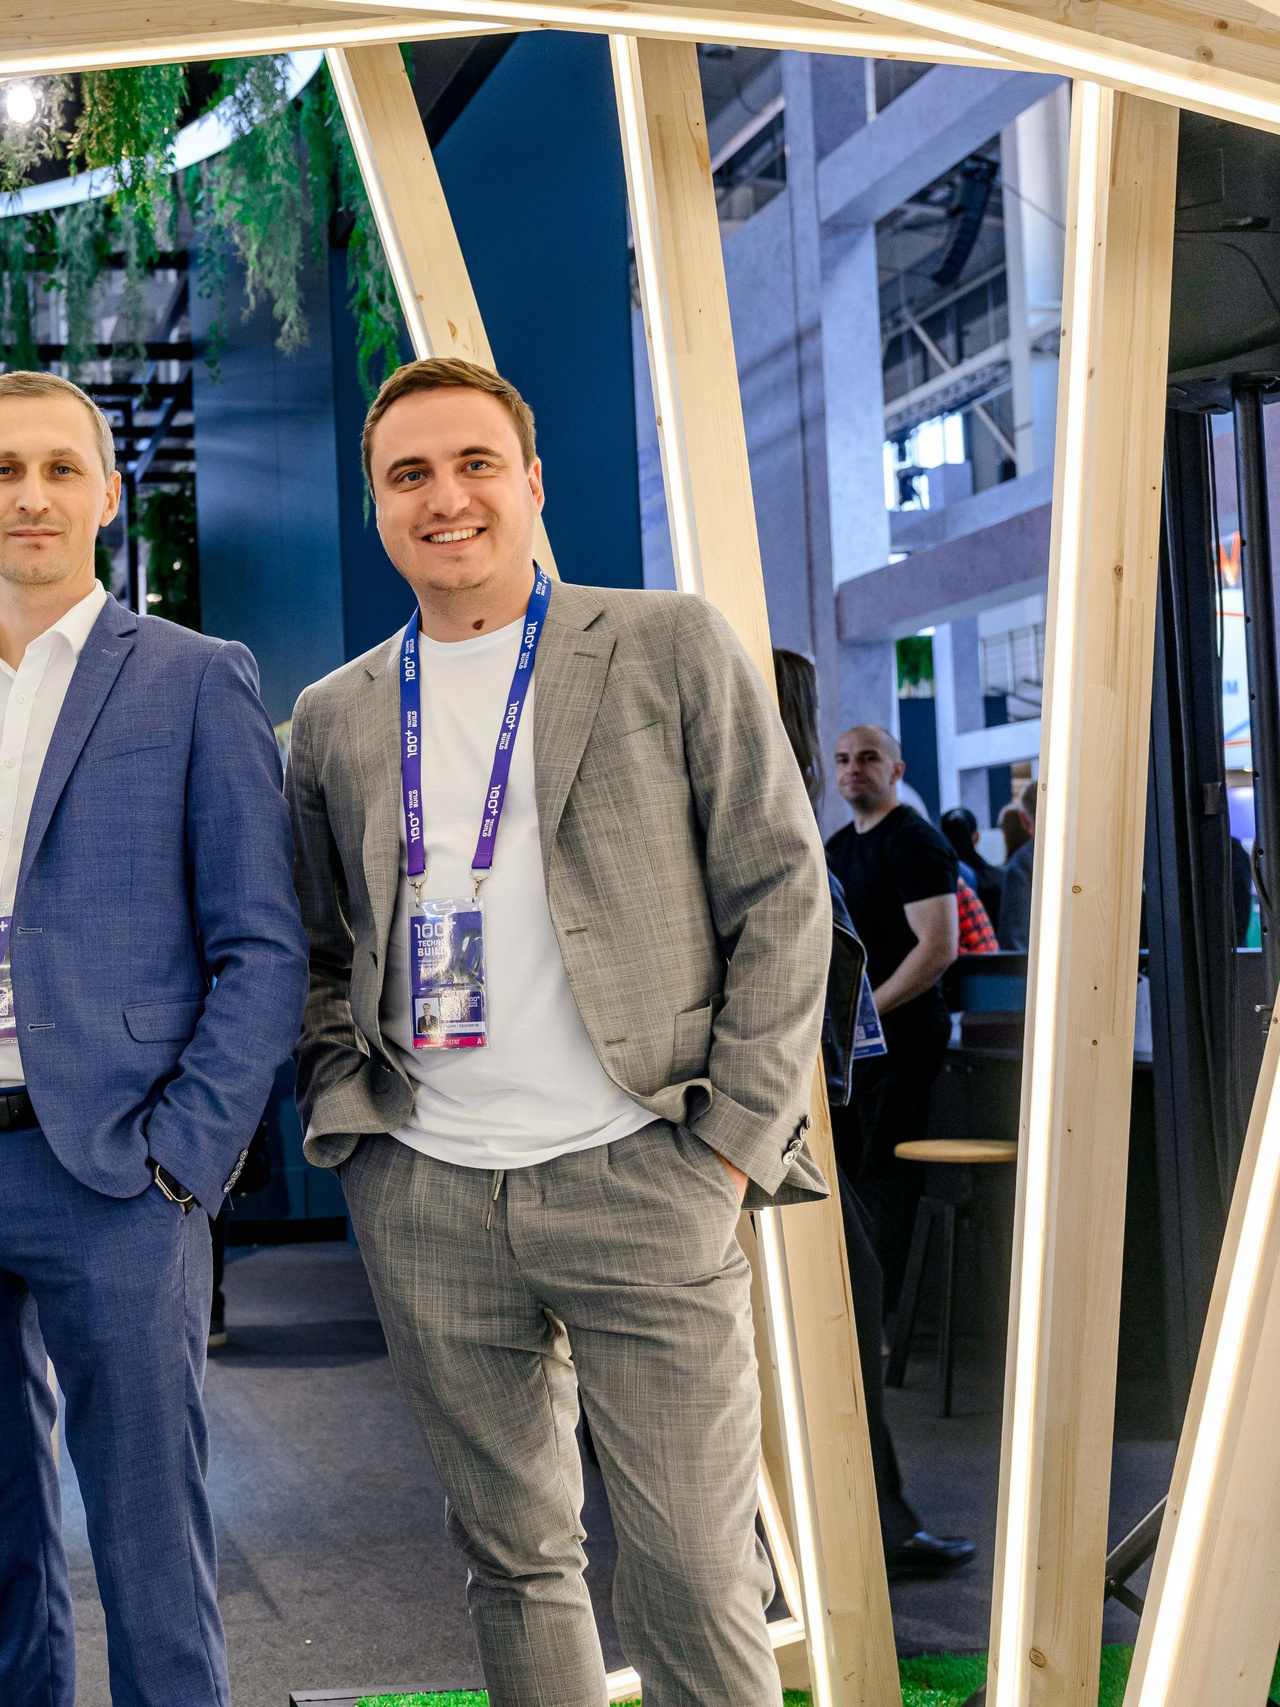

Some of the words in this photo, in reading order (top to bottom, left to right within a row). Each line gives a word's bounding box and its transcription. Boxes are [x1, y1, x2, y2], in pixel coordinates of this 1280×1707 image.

[524, 621, 538, 650] 100+
[403, 656, 416, 682] 100+
[505, 700, 520, 730] 100+
[405, 730, 418, 758] 100+
[488, 784, 501, 816] 100+
[407, 811, 421, 843] 100+
